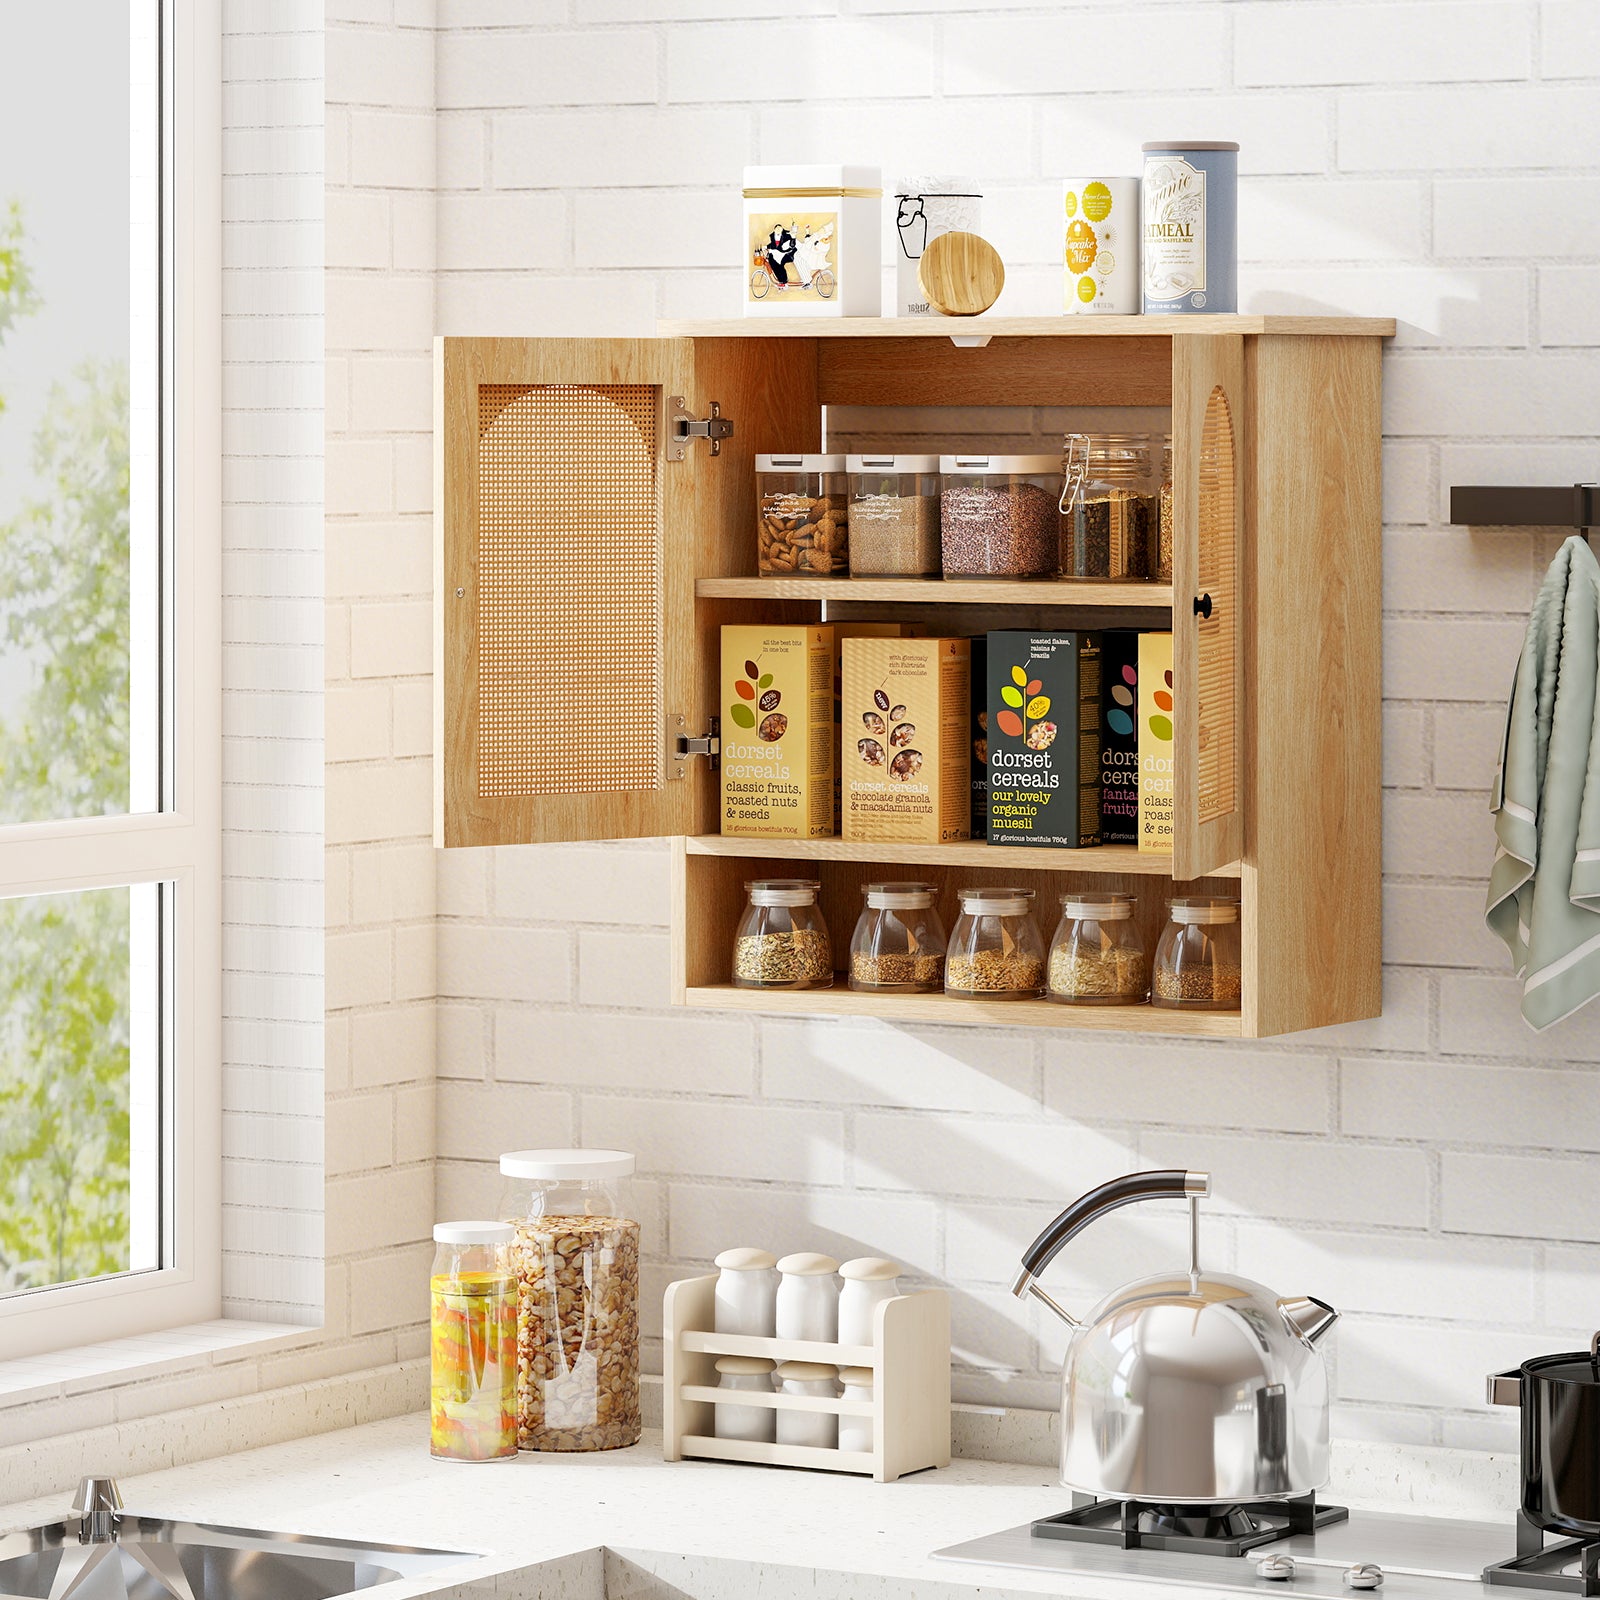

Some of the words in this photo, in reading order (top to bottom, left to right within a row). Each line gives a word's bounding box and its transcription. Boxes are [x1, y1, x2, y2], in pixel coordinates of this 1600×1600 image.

[1144, 223, 1194, 237] ATMEAL
[1071, 250, 1091, 264] Mix
[875, 692, 888, 709] new
[725, 742, 783, 760] dorset
[992, 749, 1052, 768] dorset
[725, 763, 790, 779] cereals
[992, 771, 1060, 788] cereals
[726, 781, 765, 793] classic
[767, 782, 802, 796] fruits,
[850, 780, 886, 792] dorset
[889, 782, 929, 793] cereals
[726, 795, 769, 806] roasted
[771, 798, 798, 807] nuts
[850, 791, 893, 802] chocolate
[895, 794, 931, 804] granola
[992, 791, 1014, 802] our
[1016, 790, 1051, 805] lovely
[726, 807, 736, 819] &
[739, 809, 770, 820] seeds
[850, 802, 859, 811] &
[860, 803, 912, 813] macadamia
[913, 805, 933, 814] nuts
[992, 804, 1038, 817] organic
[1102, 803, 1138, 817] fruity
[992, 818, 1033, 829] muesli
[1144, 823, 1154, 834] &
[1000, 834, 1025, 842] glorious
[1026, 835, 1051, 843] bowlfuls
[1110, 832, 1135, 840] glorious
